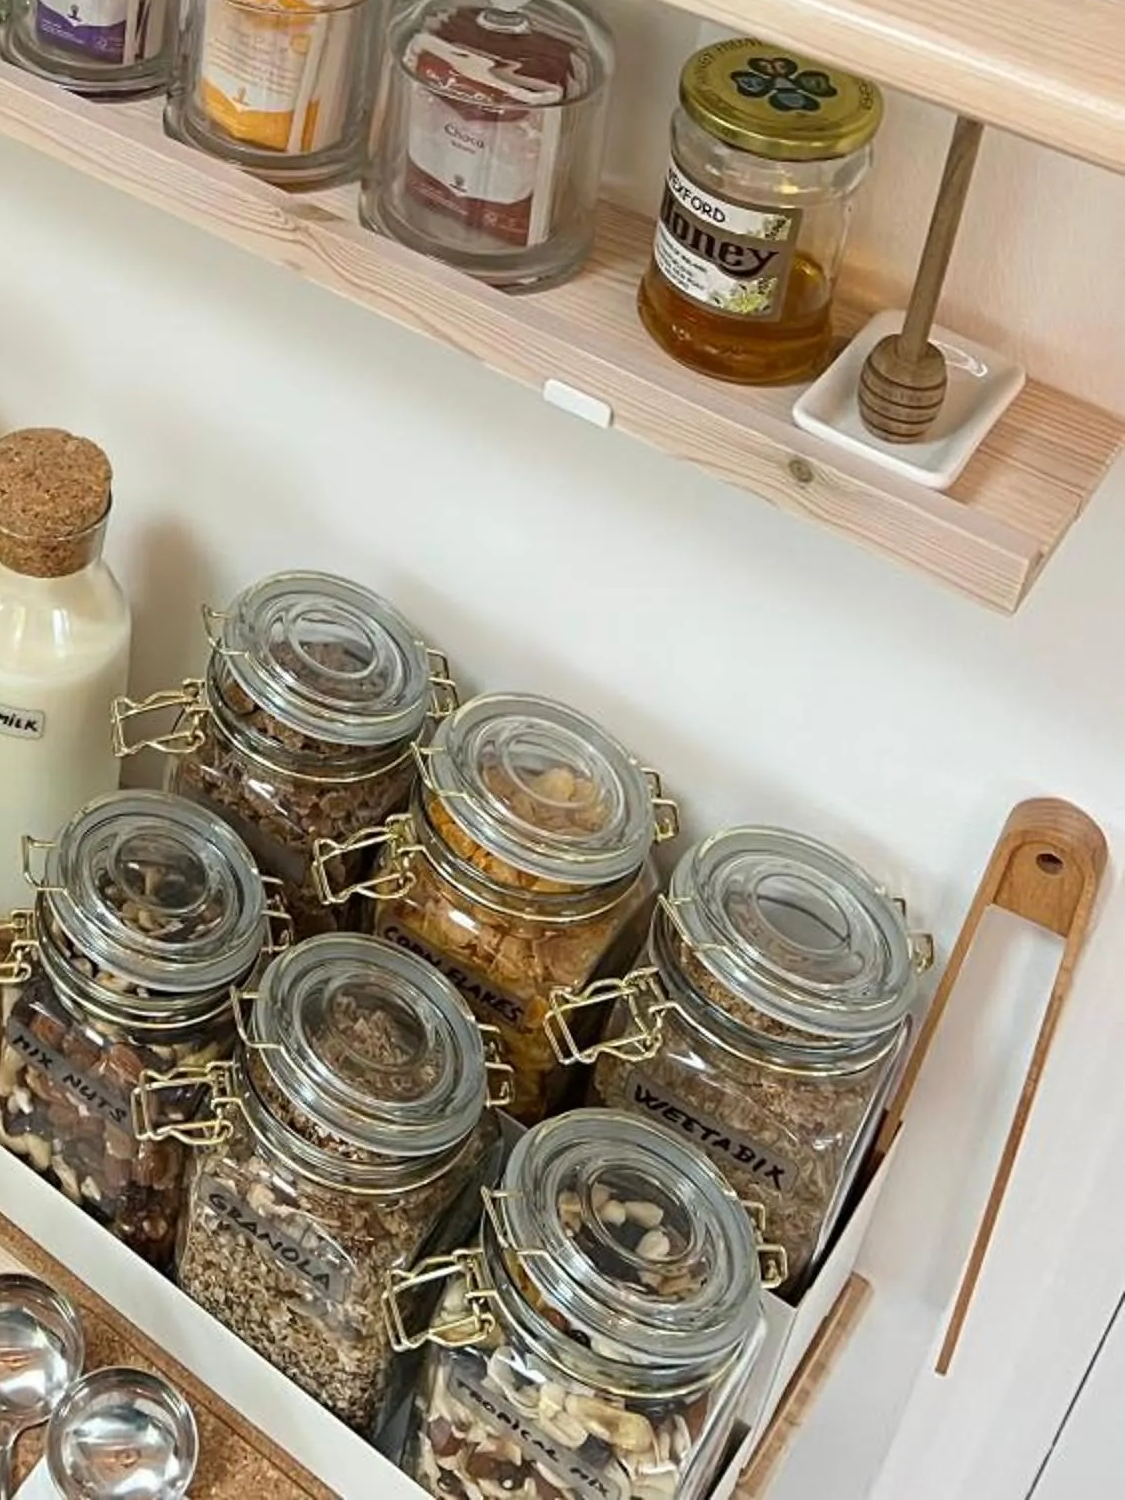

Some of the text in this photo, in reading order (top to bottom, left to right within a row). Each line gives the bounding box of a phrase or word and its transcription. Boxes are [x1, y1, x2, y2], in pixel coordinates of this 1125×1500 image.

[12, 1034, 128, 1123] MIX NUTS
[634, 1083, 785, 1191] WEETABIX
[208, 1193, 330, 1291] GRANOLA
